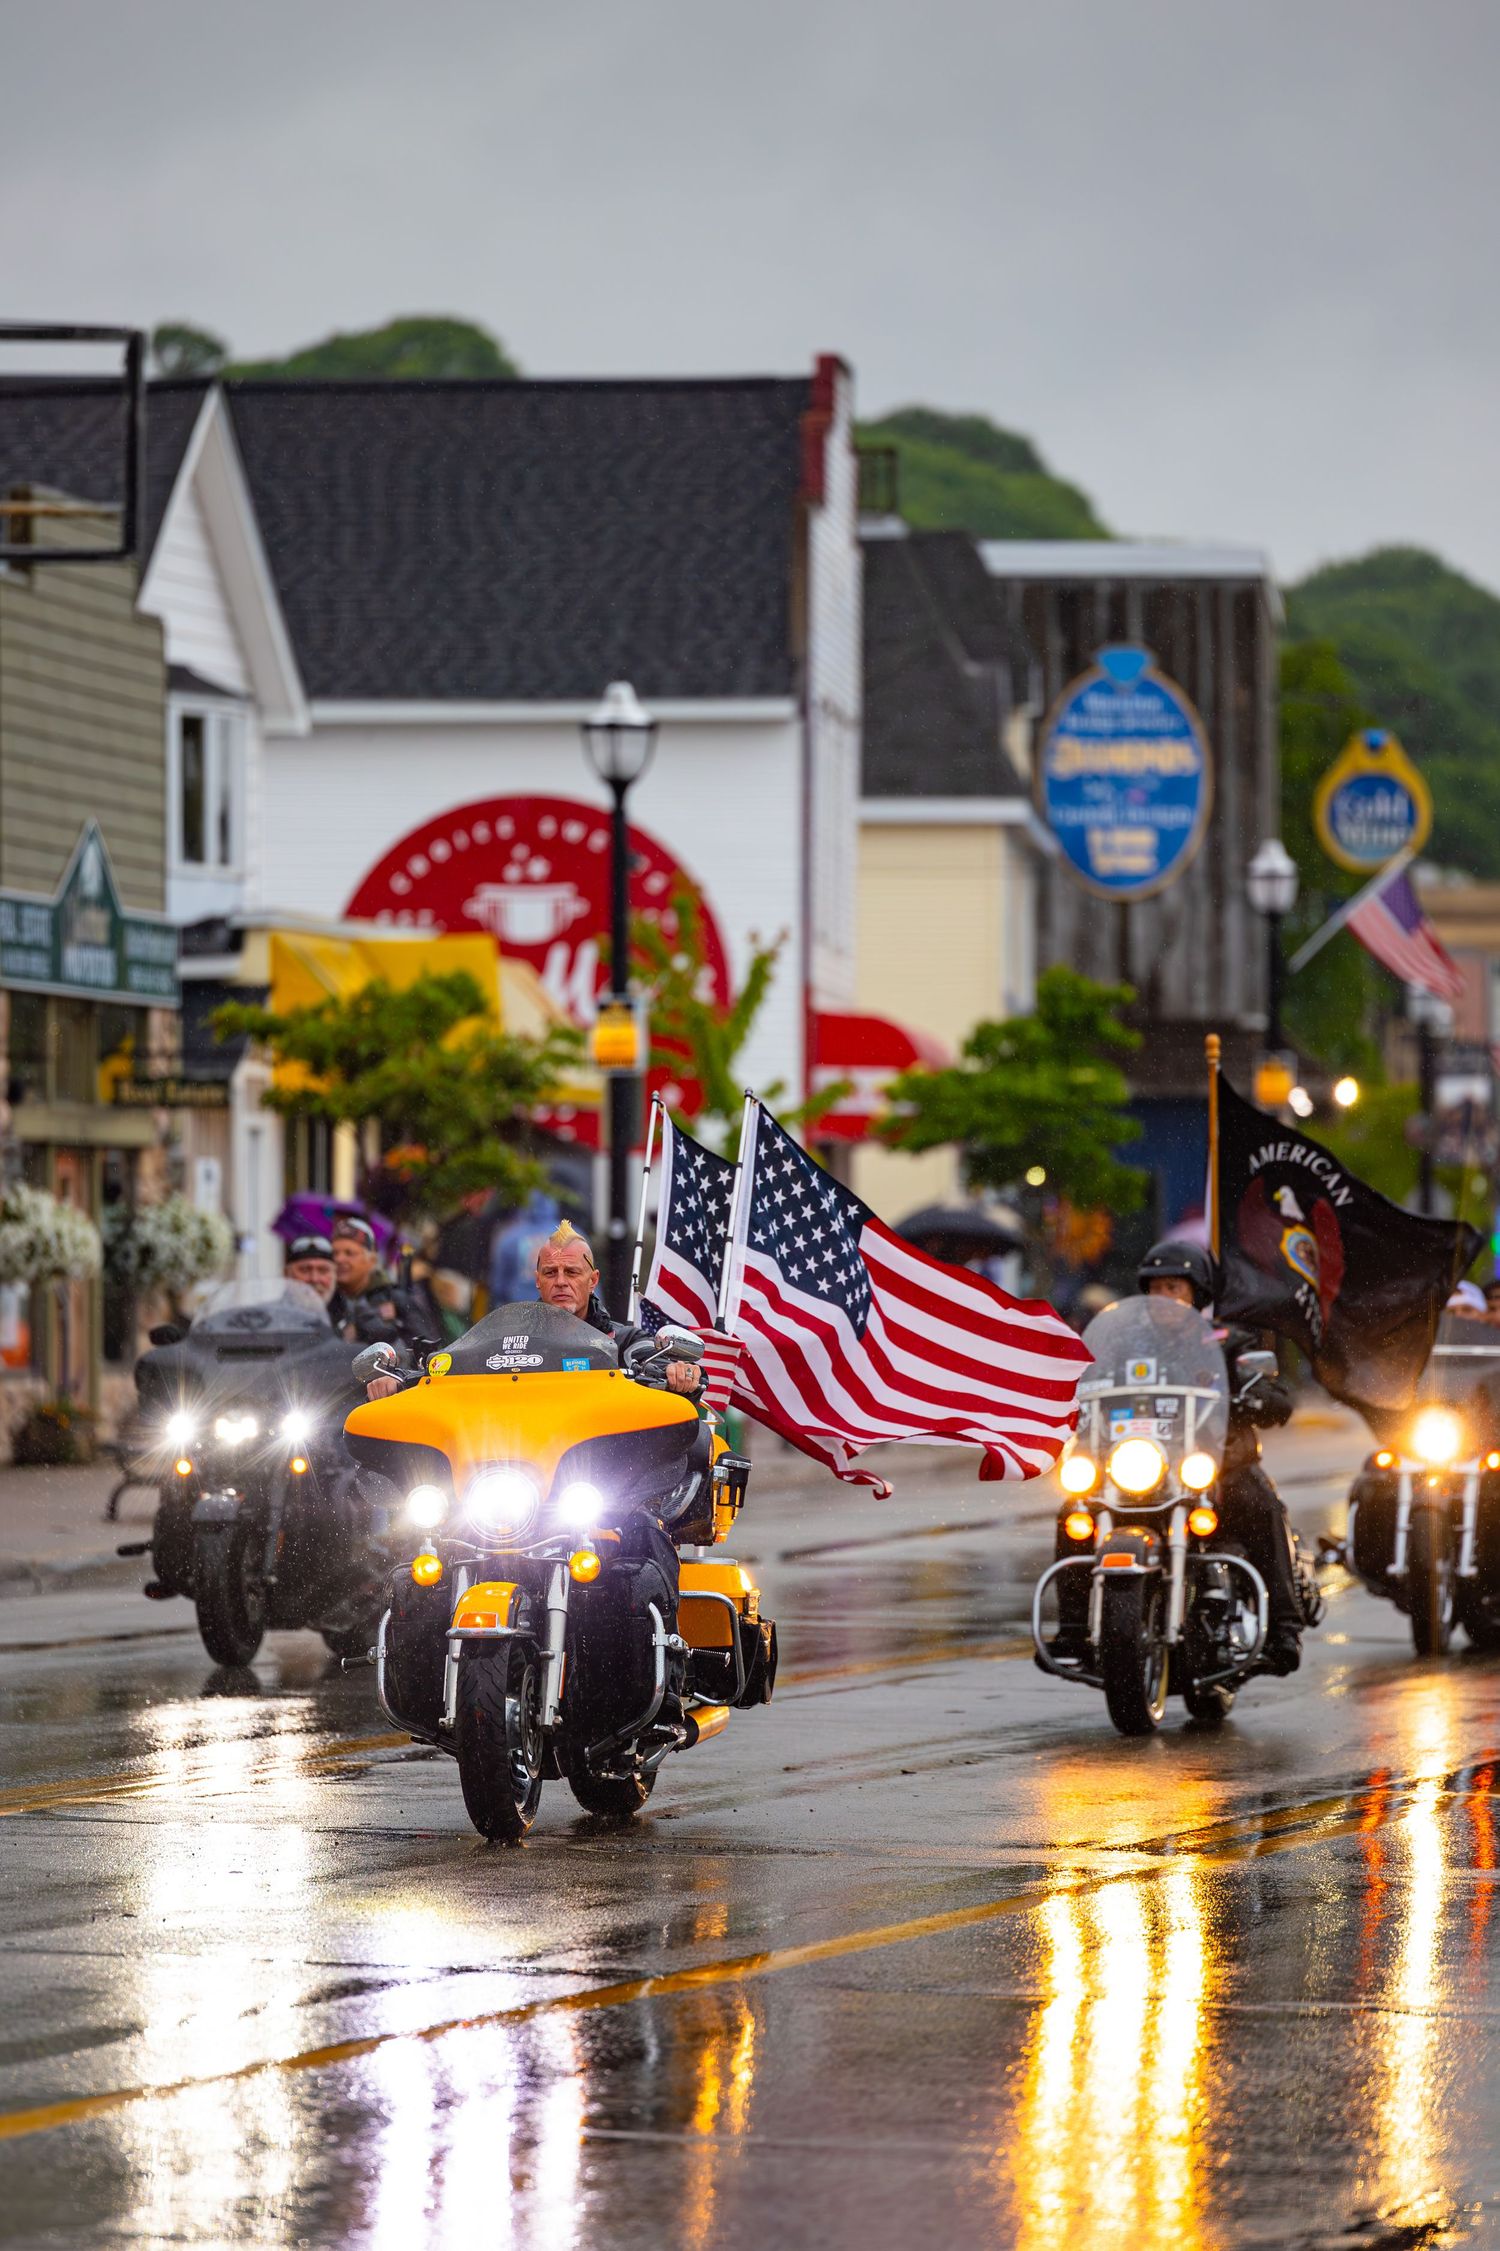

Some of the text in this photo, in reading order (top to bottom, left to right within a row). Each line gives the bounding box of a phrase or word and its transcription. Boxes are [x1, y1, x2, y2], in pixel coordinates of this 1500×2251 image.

[1249, 1141, 1354, 1207] AMERICAN
[503, 1335, 529, 1344] UNITED
[513, 1342, 527, 1350] RIDE
[508, 1355, 543, 1367] 120
